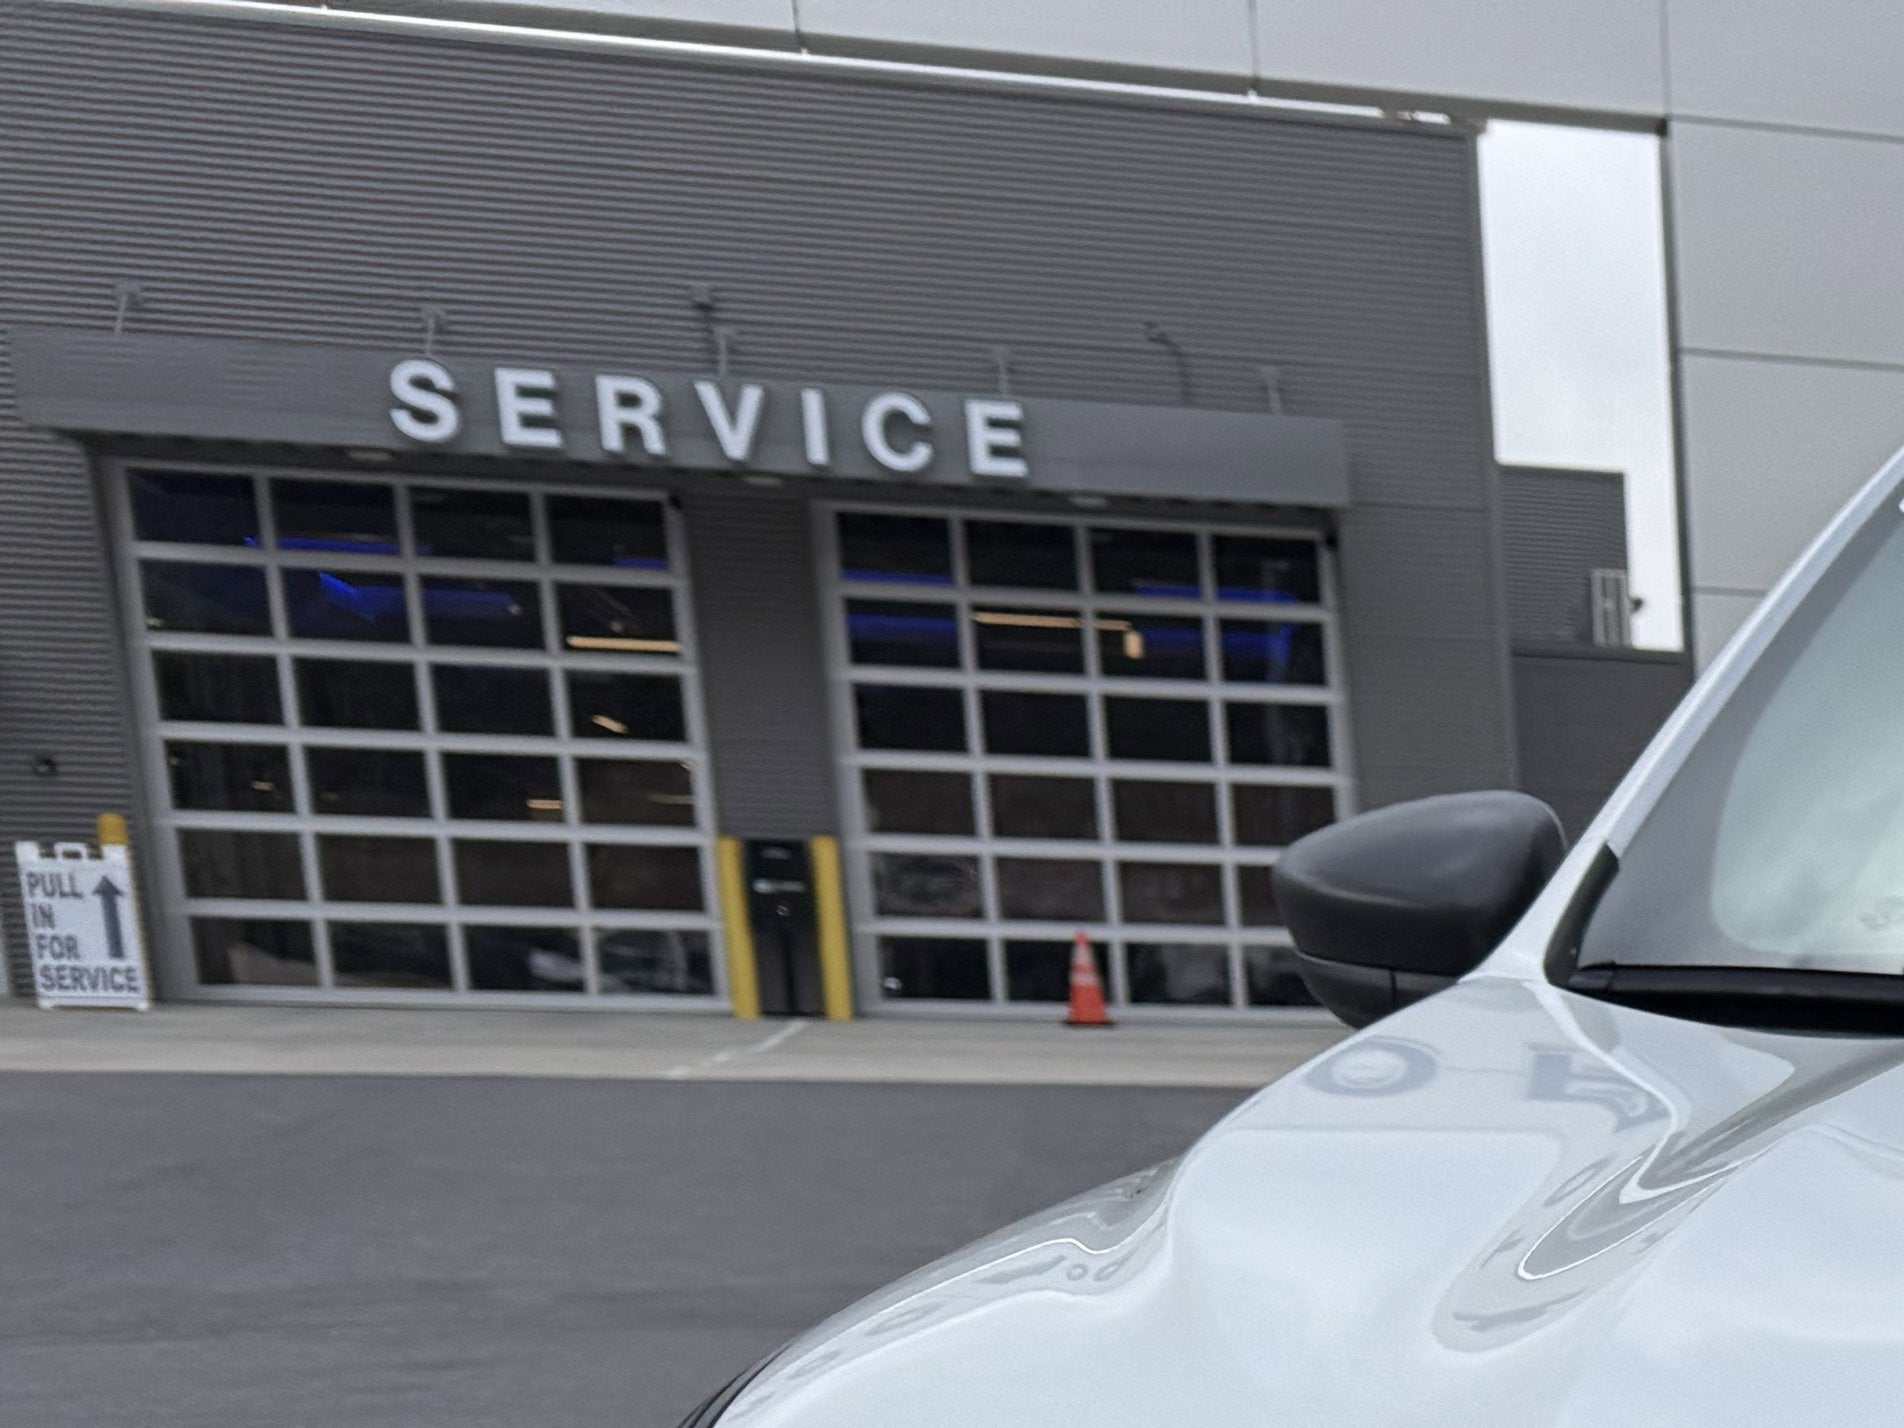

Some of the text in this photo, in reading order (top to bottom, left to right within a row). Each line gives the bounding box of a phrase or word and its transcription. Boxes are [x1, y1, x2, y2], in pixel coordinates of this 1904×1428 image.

[388, 358, 1029, 479] SERVICE
[26, 871, 83, 899] PULL
[31, 903, 55, 929] IN
[36, 934, 80, 960] FOR
[40, 964, 140, 993] SERVICE
